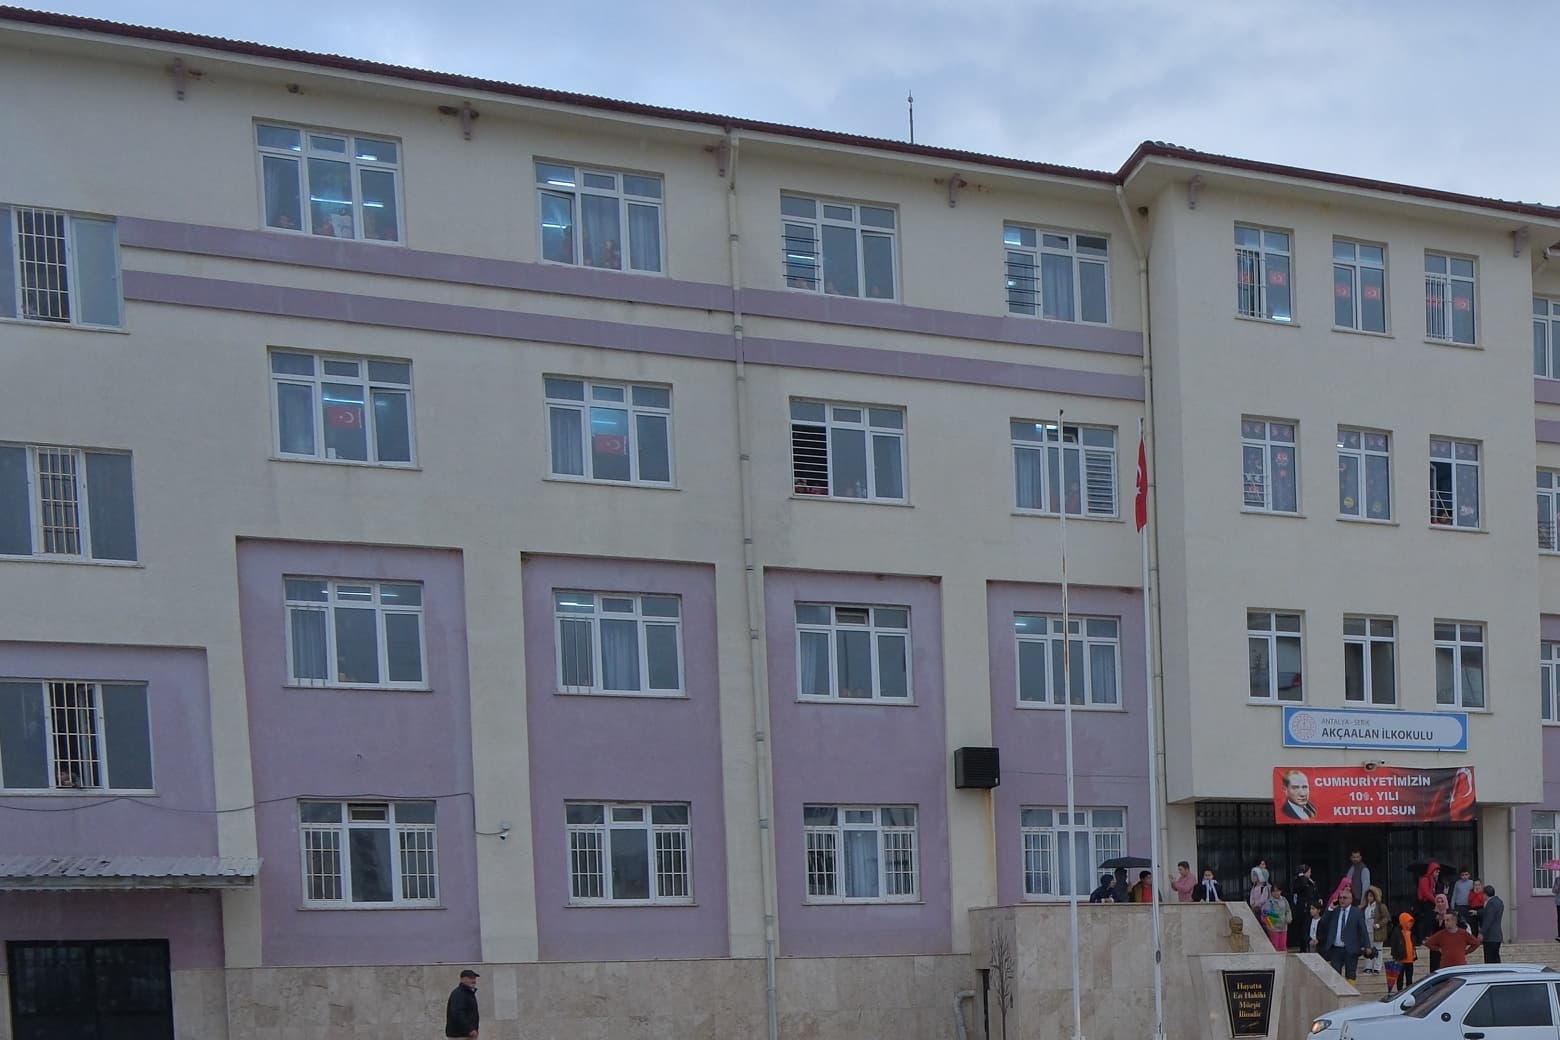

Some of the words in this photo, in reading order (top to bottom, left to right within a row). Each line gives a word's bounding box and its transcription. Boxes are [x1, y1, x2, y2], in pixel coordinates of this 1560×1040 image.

[1321, 717, 1350, 726] ANTALYA
[1321, 727, 1379, 740] AKÇAALAN
[1381, 728, 1433, 740] İLKOKULU
[1314, 774, 1431, 787] CUMHURİYETİMİZİN
[1376, 791, 1399, 801] YILI
[1333, 806, 1373, 816] KUTLU
[1376, 805, 1416, 816] OLSUN
